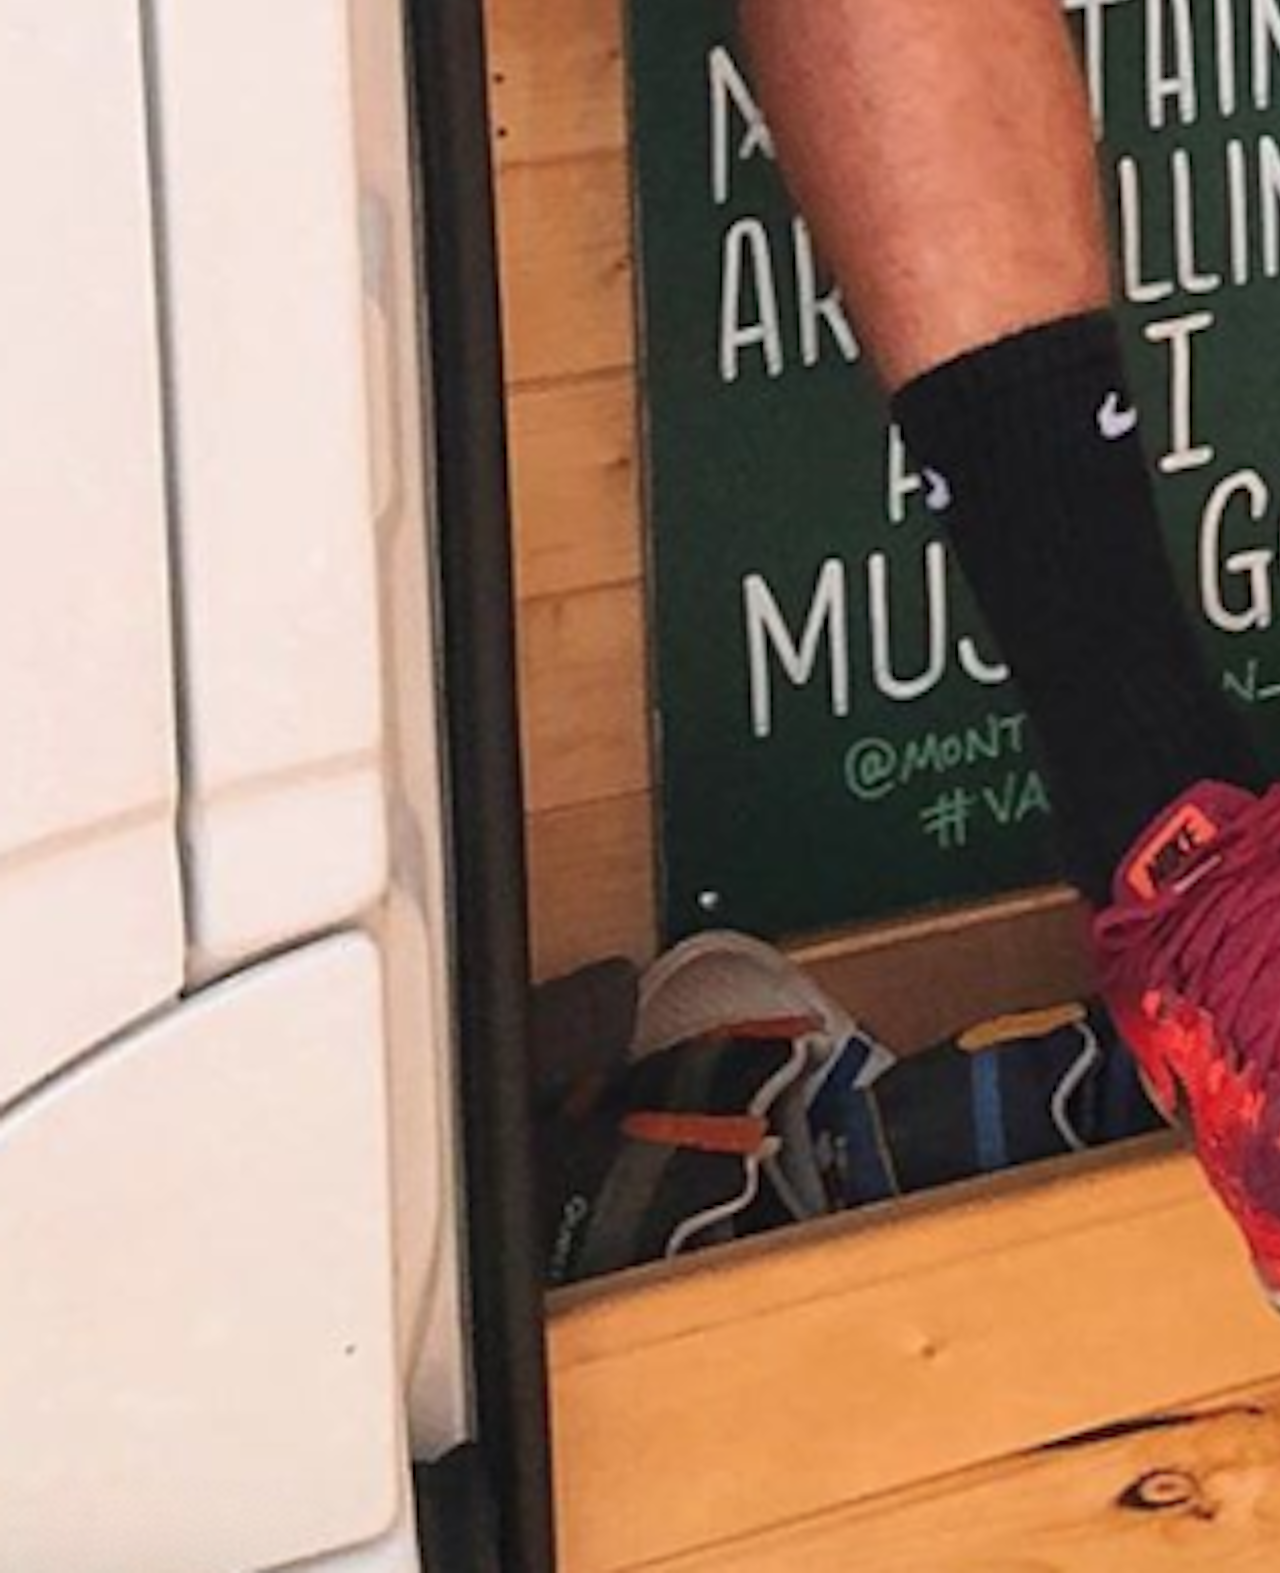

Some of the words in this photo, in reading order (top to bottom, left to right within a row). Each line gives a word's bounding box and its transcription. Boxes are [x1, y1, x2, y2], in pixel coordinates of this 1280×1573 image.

[720, 215, 861, 383] AR
[1145, 313, 1214, 472] I
[742, 541, 1010, 736] MU
